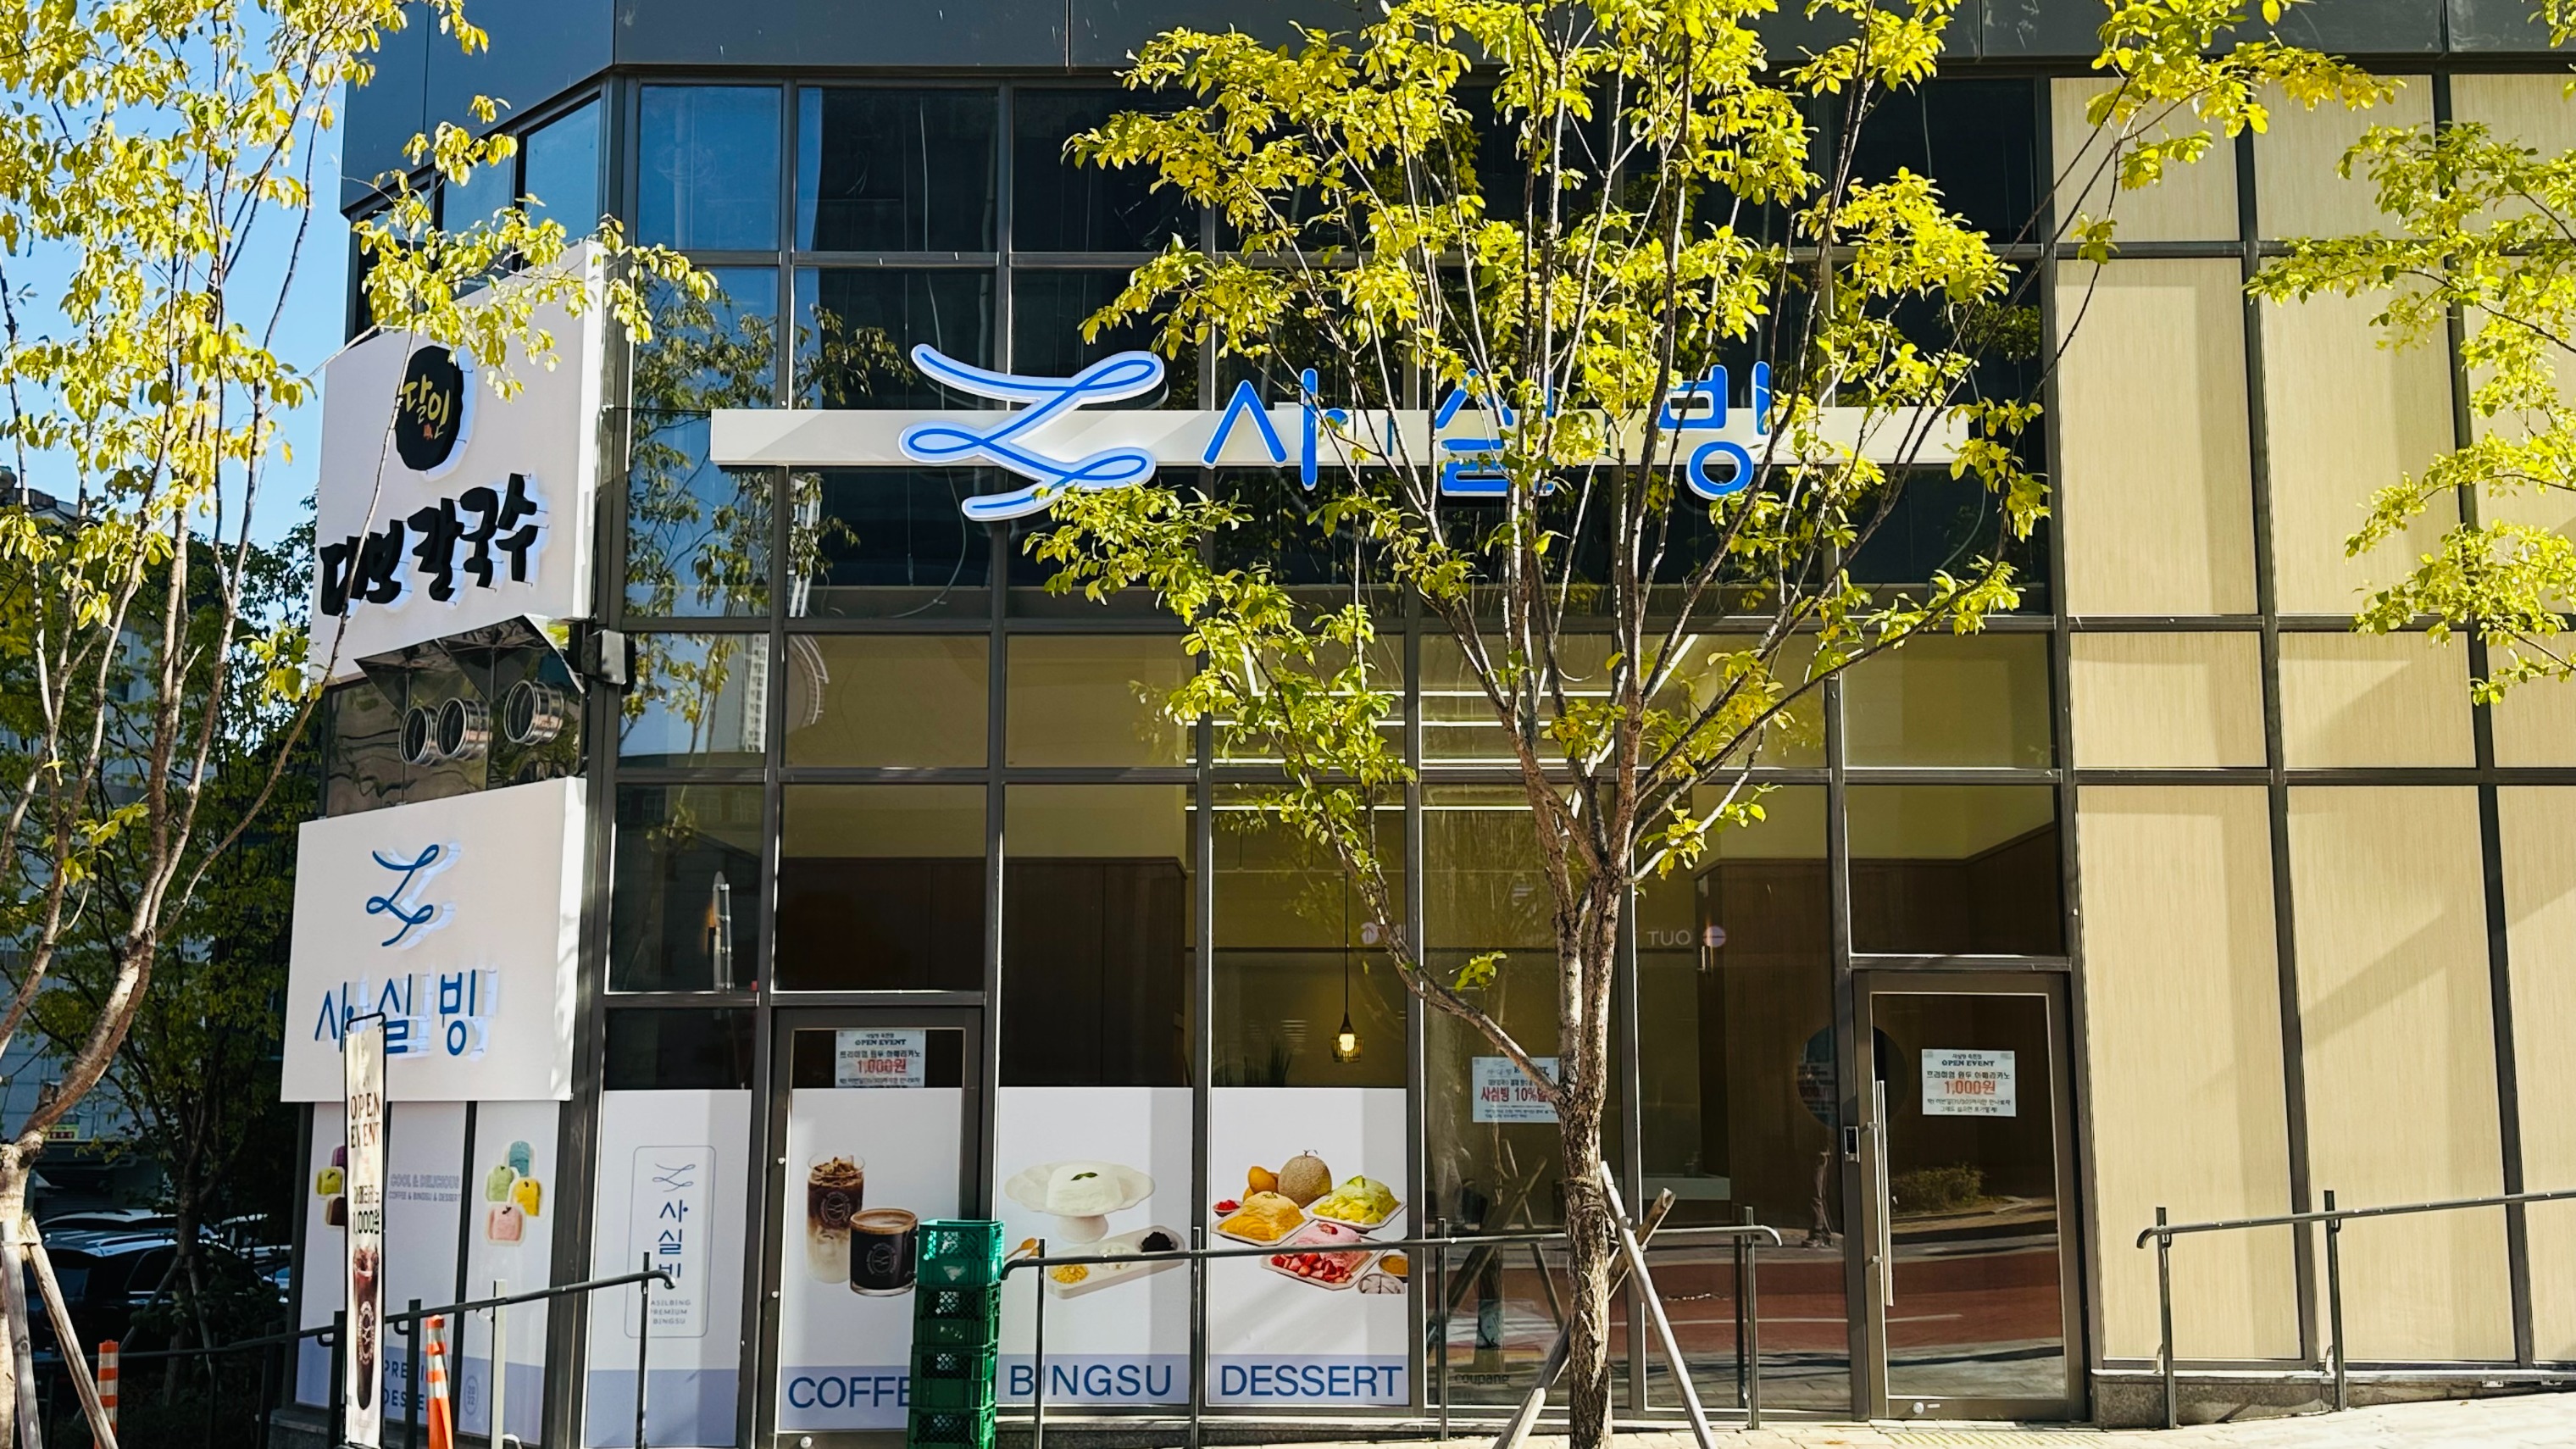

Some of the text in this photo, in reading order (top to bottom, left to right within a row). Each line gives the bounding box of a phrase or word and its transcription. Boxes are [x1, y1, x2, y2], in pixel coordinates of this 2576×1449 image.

[402, 373, 450, 440] 달인
[886, 1050, 921, 1058] 아메리카노
[857, 1058, 907, 1074] 1,000원
[1966, 1059, 1996, 1068] EVENT
[1974, 1071, 2011, 1080] 아메리카노
[1944, 1080, 1996, 1096] 1,000원
[350, 1090, 380, 1120] OPEN
[350, 1122, 380, 1149] EVENT
[353, 1208, 380, 1236] 1,000원
[1220, 1364, 1404, 1398] DESSERT
[1454, 1373, 1511, 1388] coupang
